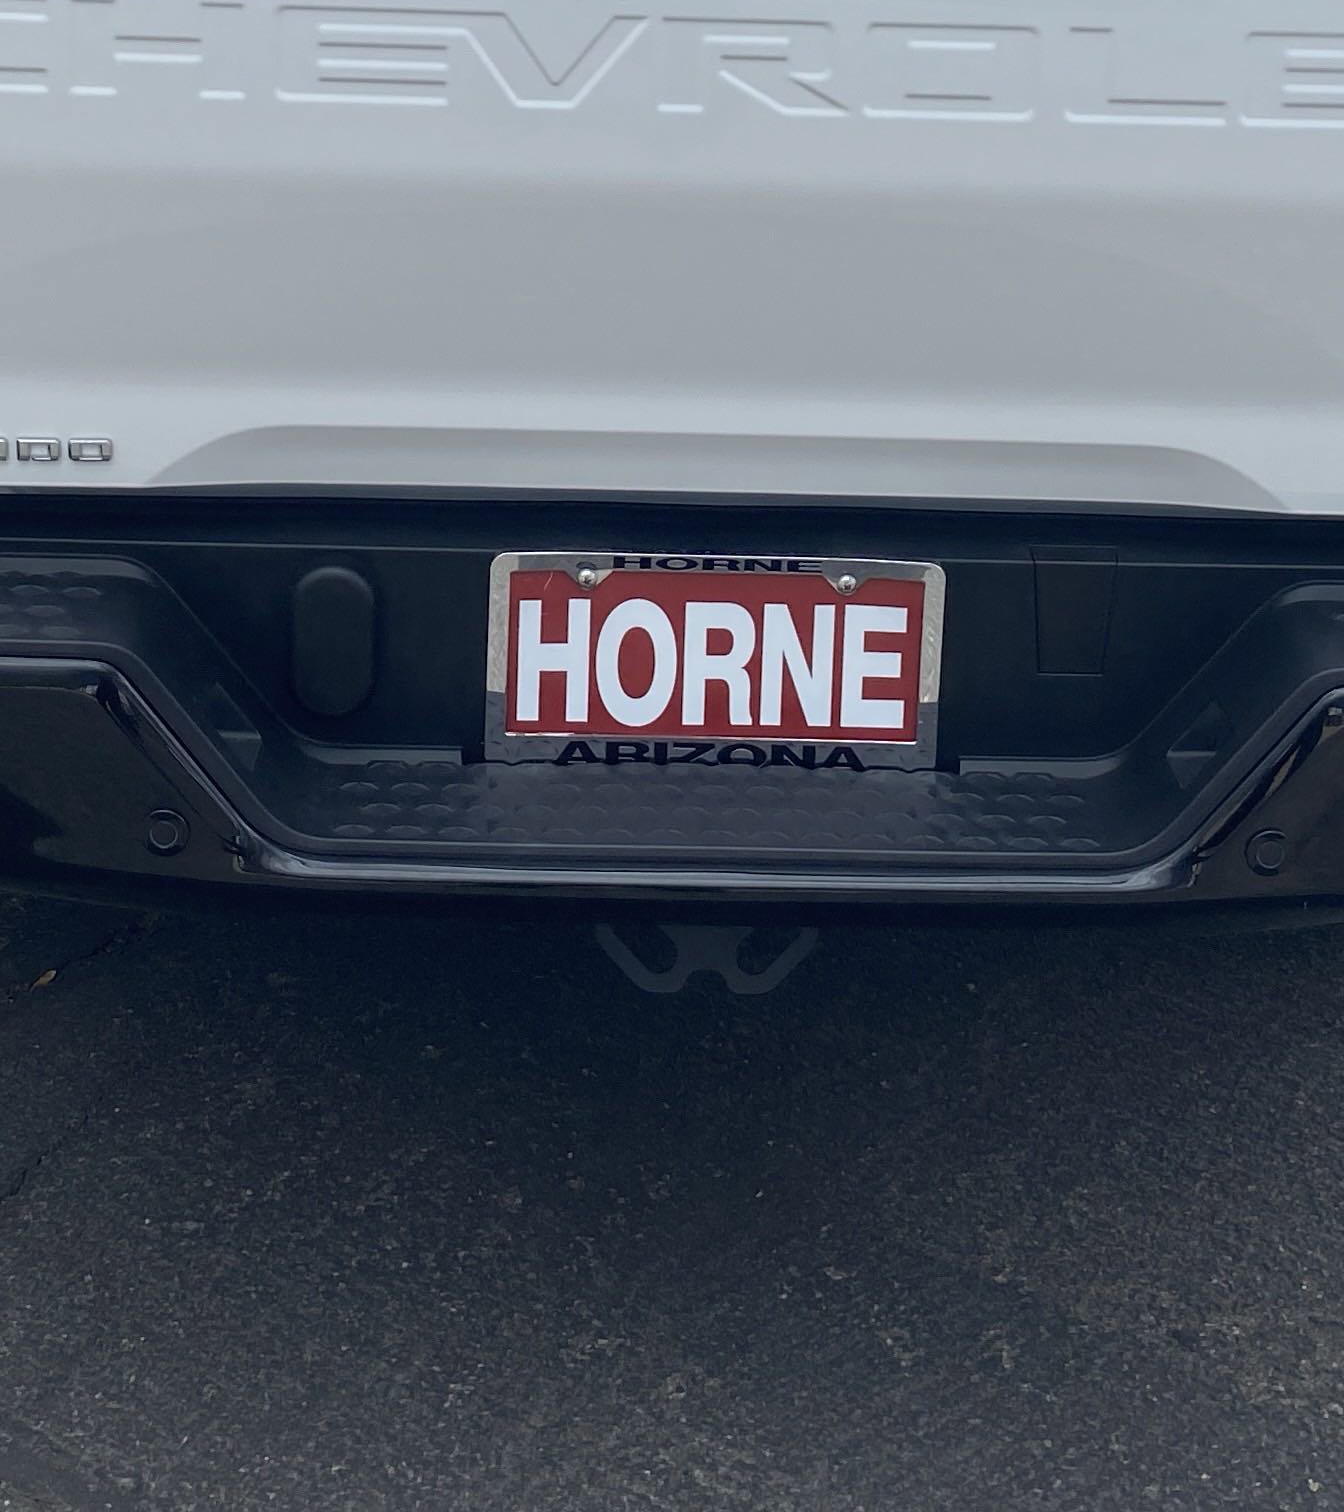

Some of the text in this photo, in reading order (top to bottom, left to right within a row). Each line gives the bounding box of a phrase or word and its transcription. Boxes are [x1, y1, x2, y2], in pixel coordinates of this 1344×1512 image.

[612, 554, 824, 573] HORNE
[516, 598, 909, 730] HORNE
[556, 740, 866, 771] ARIZONA
